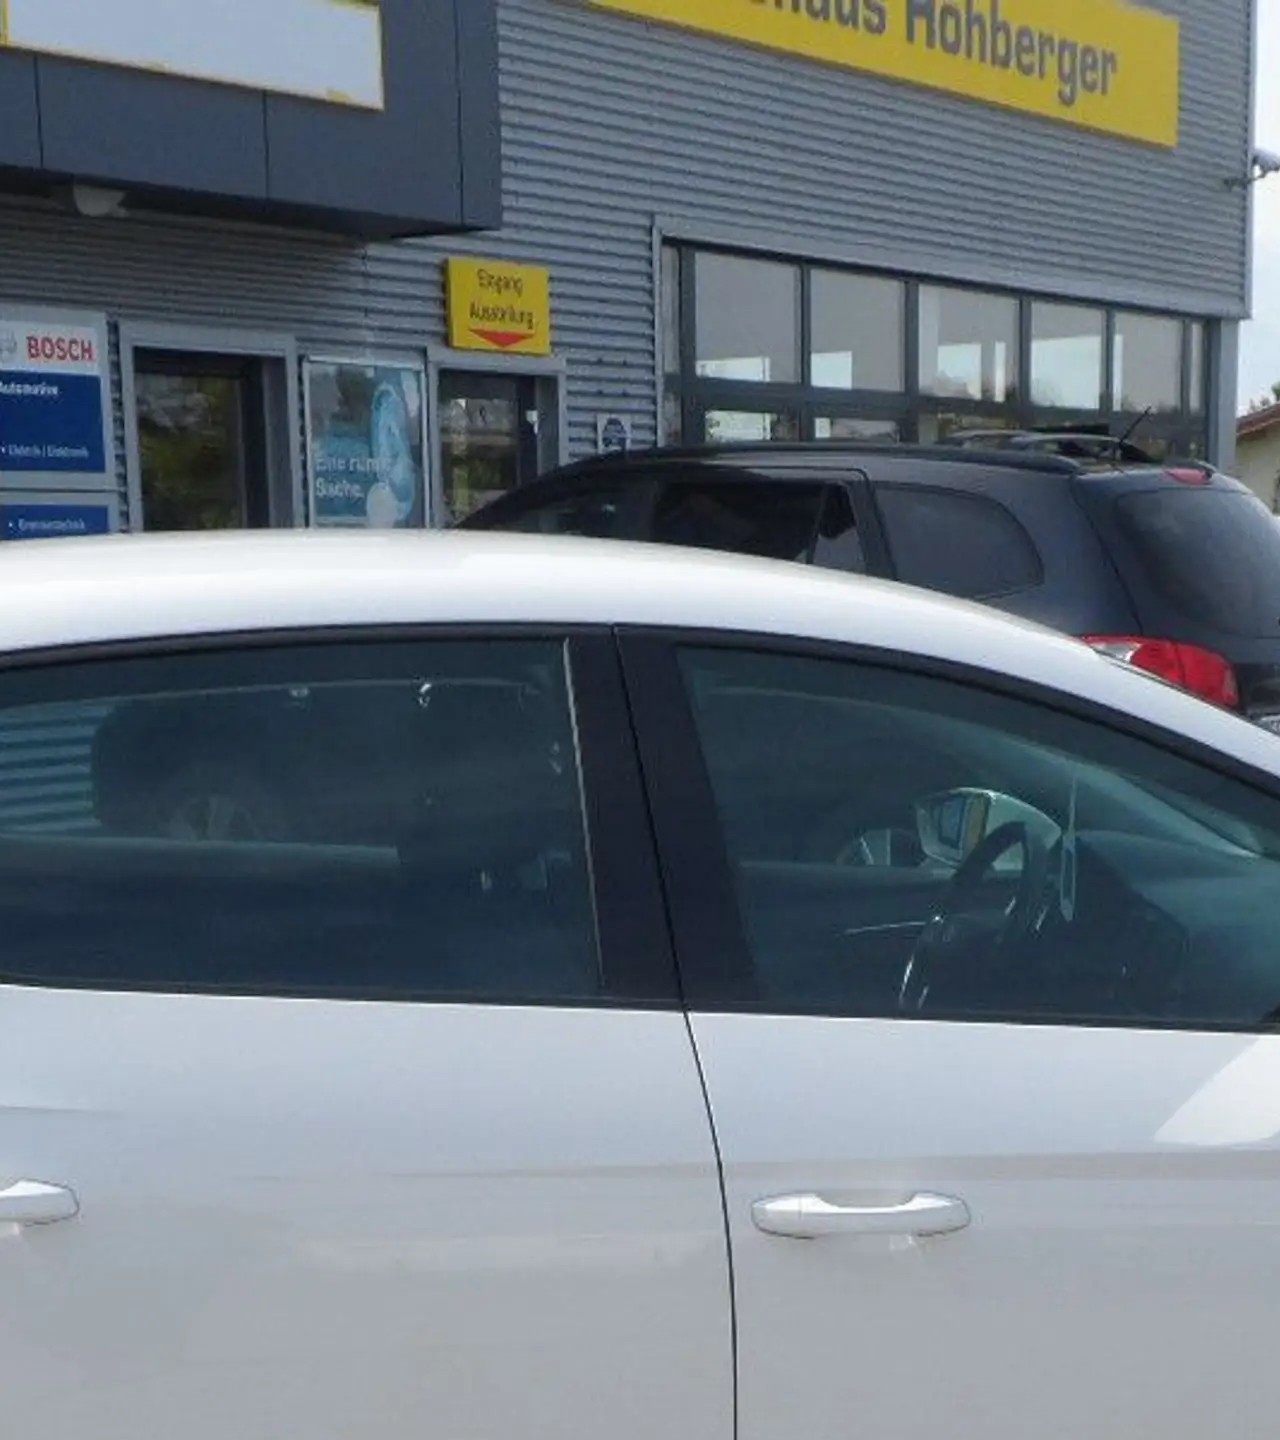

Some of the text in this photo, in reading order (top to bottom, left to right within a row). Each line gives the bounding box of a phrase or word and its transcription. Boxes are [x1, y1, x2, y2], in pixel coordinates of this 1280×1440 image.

[904, 0, 1118, 107] Hohberger
[477, 268, 523, 298] Eingang
[26, 335, 94, 361] BOSCH
